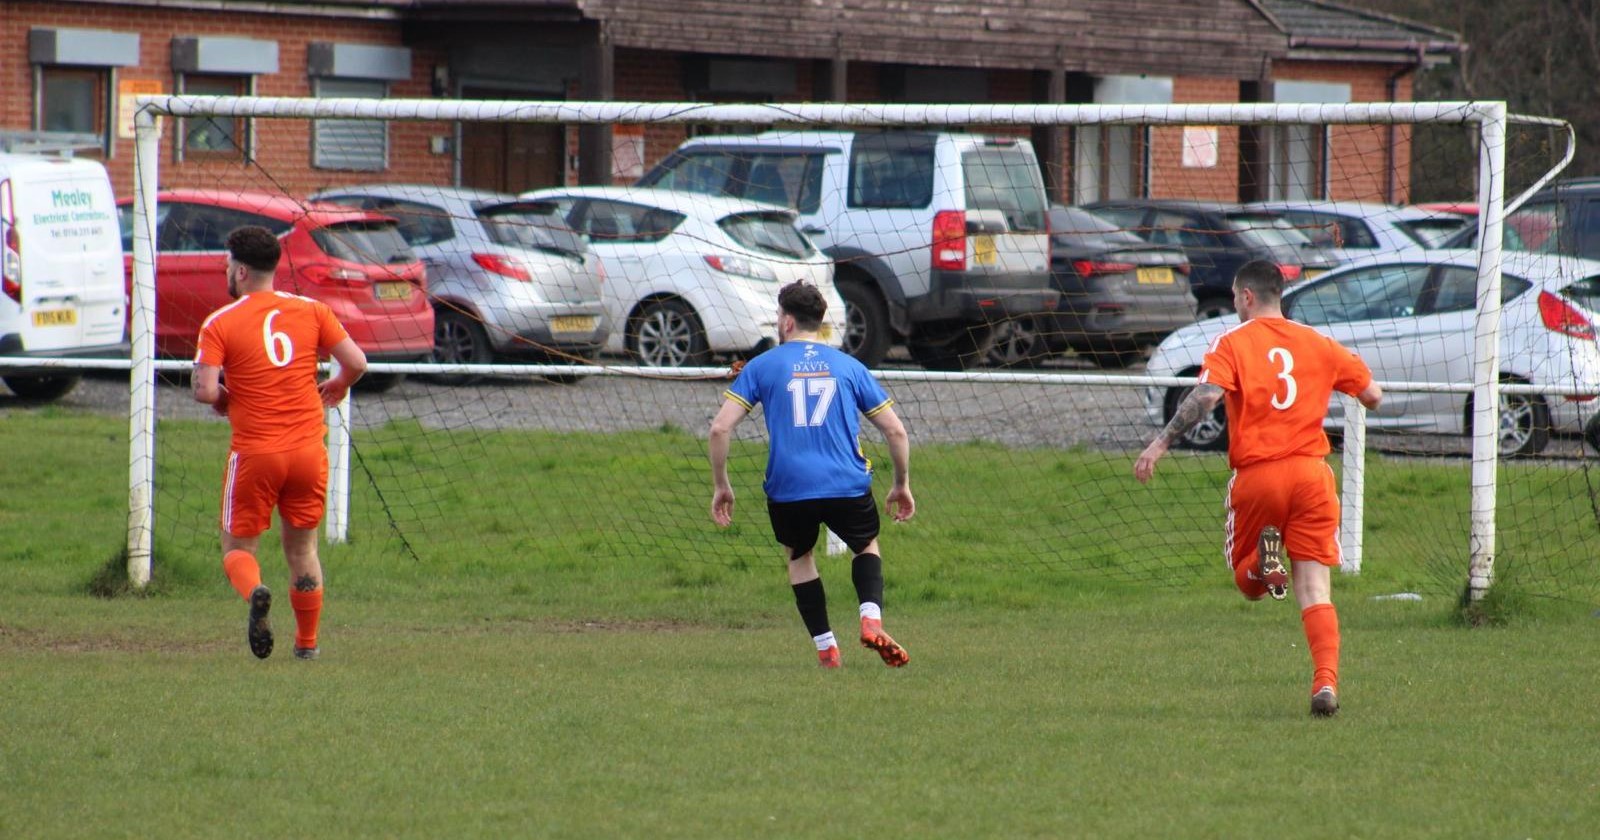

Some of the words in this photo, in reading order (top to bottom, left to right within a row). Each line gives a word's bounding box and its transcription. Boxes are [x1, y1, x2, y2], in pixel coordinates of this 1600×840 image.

[51, 188, 92, 209] Mealey
[33, 212, 69, 225] Electrical
[262, 309, 294, 367] 6
[793, 363, 829, 371] DAVIS
[1267, 347, 1298, 411] 3
[787, 377, 837, 428] 17
